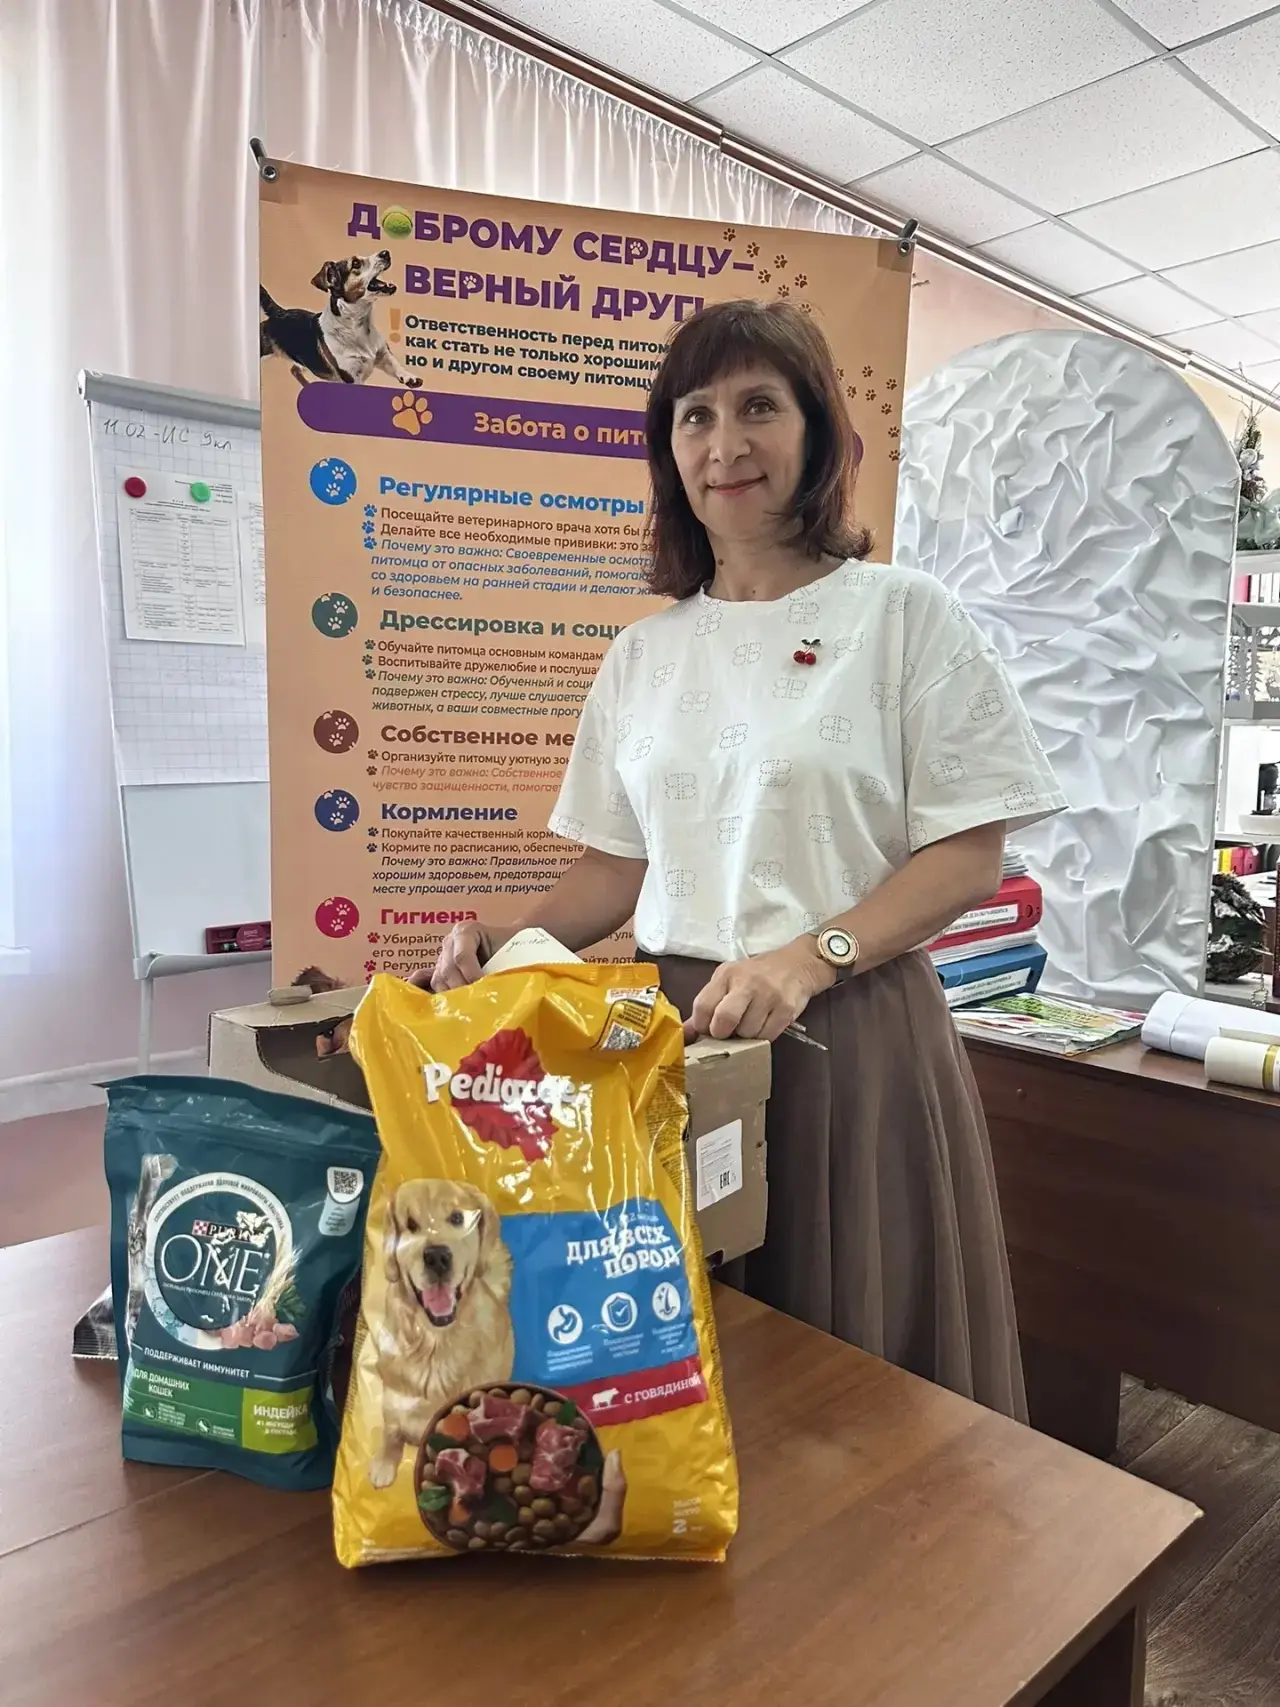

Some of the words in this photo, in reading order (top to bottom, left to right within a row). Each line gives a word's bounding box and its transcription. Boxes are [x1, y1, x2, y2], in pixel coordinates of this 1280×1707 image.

[404, 265, 580, 313] ВЕРНЫЙ
[404, 314, 558, 344] Ответственность
[561, 331, 614, 353] перед
[404, 335, 437, 352] как
[441, 341, 489, 357] стать
[494, 345, 515, 360] не
[518, 345, 579, 366] только
[584, 353, 662, 372] хорошим
[404, 353, 427, 368] но
[432, 356, 443, 370] и
[448, 357, 513, 381] другом
[517, 364, 579, 385] своему
[473, 411, 566, 440] Забота
[573, 424, 588, 442] о
[379, 476, 533, 507] Регулярные
[540, 492, 644, 516] осмотры
[381, 507, 454, 525] Посещайте
[457, 516, 553, 533] ветеринарного
[556, 521, 591, 535] врача
[594, 525, 620, 535] хотя
[623, 525, 640, 536] бы
[380, 523, 437, 540] Делайте
[439, 530, 461, 541] все
[464, 531, 551, 546] необходимые
[554, 536, 617, 552] прививки:
[620, 542, 639, 551] это
[381, 539, 431, 557] Почему
[434, 543, 455, 554] это
[458, 545, 503, 558] важно:
[505, 548, 606, 565] Своевременные
[370, 554, 428, 570] питомца
[431, 559, 446, 570] от
[448, 559, 504, 573] опасных
[507, 562, 591, 580] заболеваний,
[370, 571, 386, 581] со
[389, 571, 460, 589] здоровьем
[463, 576, 479, 586] на
[482, 575, 530, 592] ранней
[533, 580, 577, 593] стадии
[579, 584, 587, 593] и
[590, 584, 636, 596] делают
[370, 587, 380, 596] и
[383, 585, 463, 601] безопаснее.
[379, 609, 544, 636] Дрессировка
[551, 622, 565, 636] и
[377, 640, 433, 656] Обучайте
[437, 644, 486, 657] питомца
[488, 647, 546, 658] основным
[378, 656, 462, 671] Воспитывайте
[464, 660, 537, 675] дружелюбие
[540, 664, 547, 673] и
[378, 670, 423, 686] Почему
[425, 674, 445, 684] это
[447, 675, 487, 686] важно:
[490, 675, 554, 689] Обученный
[556, 680, 564, 688] и
[371, 685, 438, 701] подвержен
[441, 689, 487, 702] стрессу,
[490, 691, 526, 703] лучше
[528, 692, 587, 704] слушается
[371, 700, 434, 714] животных,
[436, 704, 444, 712] а
[446, 704, 478, 715] ваши
[480, 704, 548, 716] совместные
[550, 707, 583, 718] прогу
[380, 724, 539, 746] Собственное
[545, 732, 575, 746] ме
[381, 751, 456, 766] Организуйте
[458, 754, 506, 767] питомцу
[508, 755, 551, 767] уютную
[381, 765, 426, 779] Почему
[428, 768, 447, 778] это
[449, 768, 489, 778] важно:
[491, 767, 562, 778] Собственное
[372, 779, 417, 792] чувство
[419, 780, 510, 794] защищенности,
[381, 803, 518, 823] Кормление
[381, 827, 442, 842] Покупайте
[444, 827, 524, 840] качественный
[526, 830, 554, 842] корм
[381, 842, 431, 856] Кормите
[433, 845, 448, 853] по
[450, 844, 520, 857] расписанию,
[523, 842, 584, 853] обеспечьте
[381, 856, 425, 869] Почему
[427, 857, 446, 866] это
[448, 857, 488, 866] важно:
[490, 855, 557, 867] Правильное
[372, 869, 425, 882] хорошим
[428, 869, 491, 882] здоровьем,
[372, 884, 406, 894] месте
[407, 884, 465, 897] упрощает
[467, 883, 492, 895] уход
[494, 884, 502, 893] и
[381, 908, 477, 924] Гигиена
[383, 933, 445, 945] Убирайте
[372, 949, 394, 957] его
[617, 1225, 671, 1248] ВСЕХ
[161, 1234, 260, 1296] ONE
[603, 1245, 681, 1279] ПОРОД
[144, 1347, 201, 1369] ПОДДЕРЖИВАЕТ
[203, 1362, 251, 1378] ИММУНИТЕТ
[133, 1369, 148, 1379] ДЛЯ
[148, 1372, 190, 1391] ДОМАШНИХ
[634, 1372, 702, 1403] ГОВЯДИНОЙ
[148, 1385, 173, 1398] КОШЕК
[253, 1403, 308, 1419] ИНДЕЙКА
